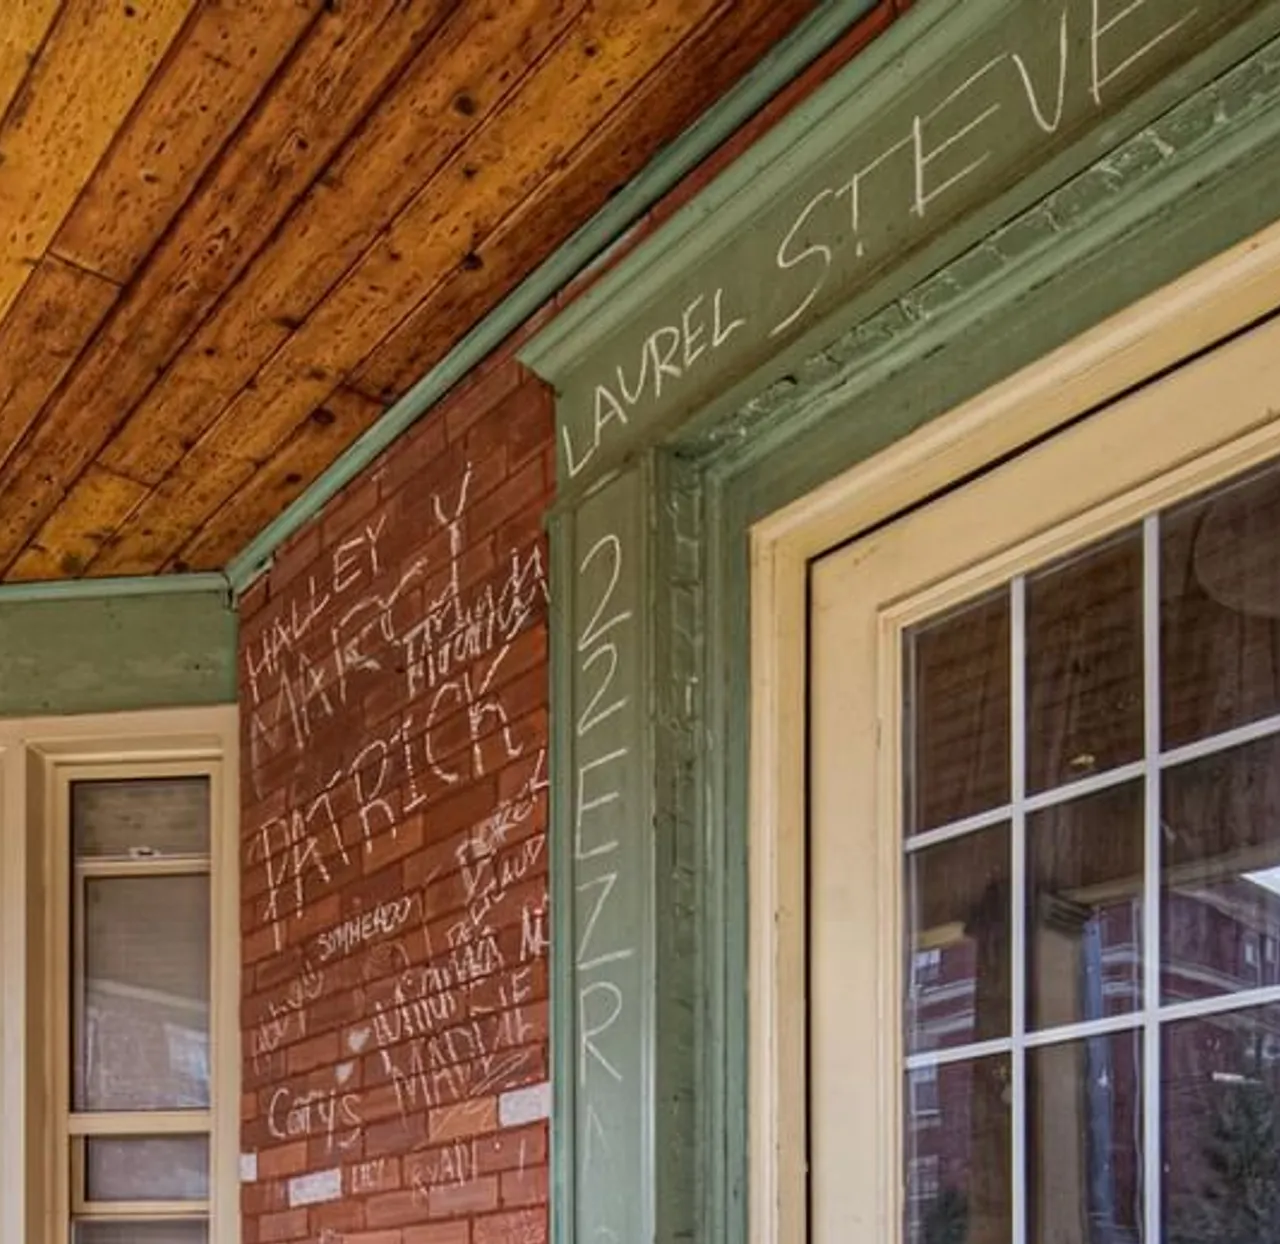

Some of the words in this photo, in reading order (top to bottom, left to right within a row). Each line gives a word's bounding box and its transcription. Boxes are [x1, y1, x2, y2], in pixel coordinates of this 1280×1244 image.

[561, 288, 745, 478] LAUREL
[246, 515, 387, 703] HALLEY
[260, 643, 523, 951] PATRICK
